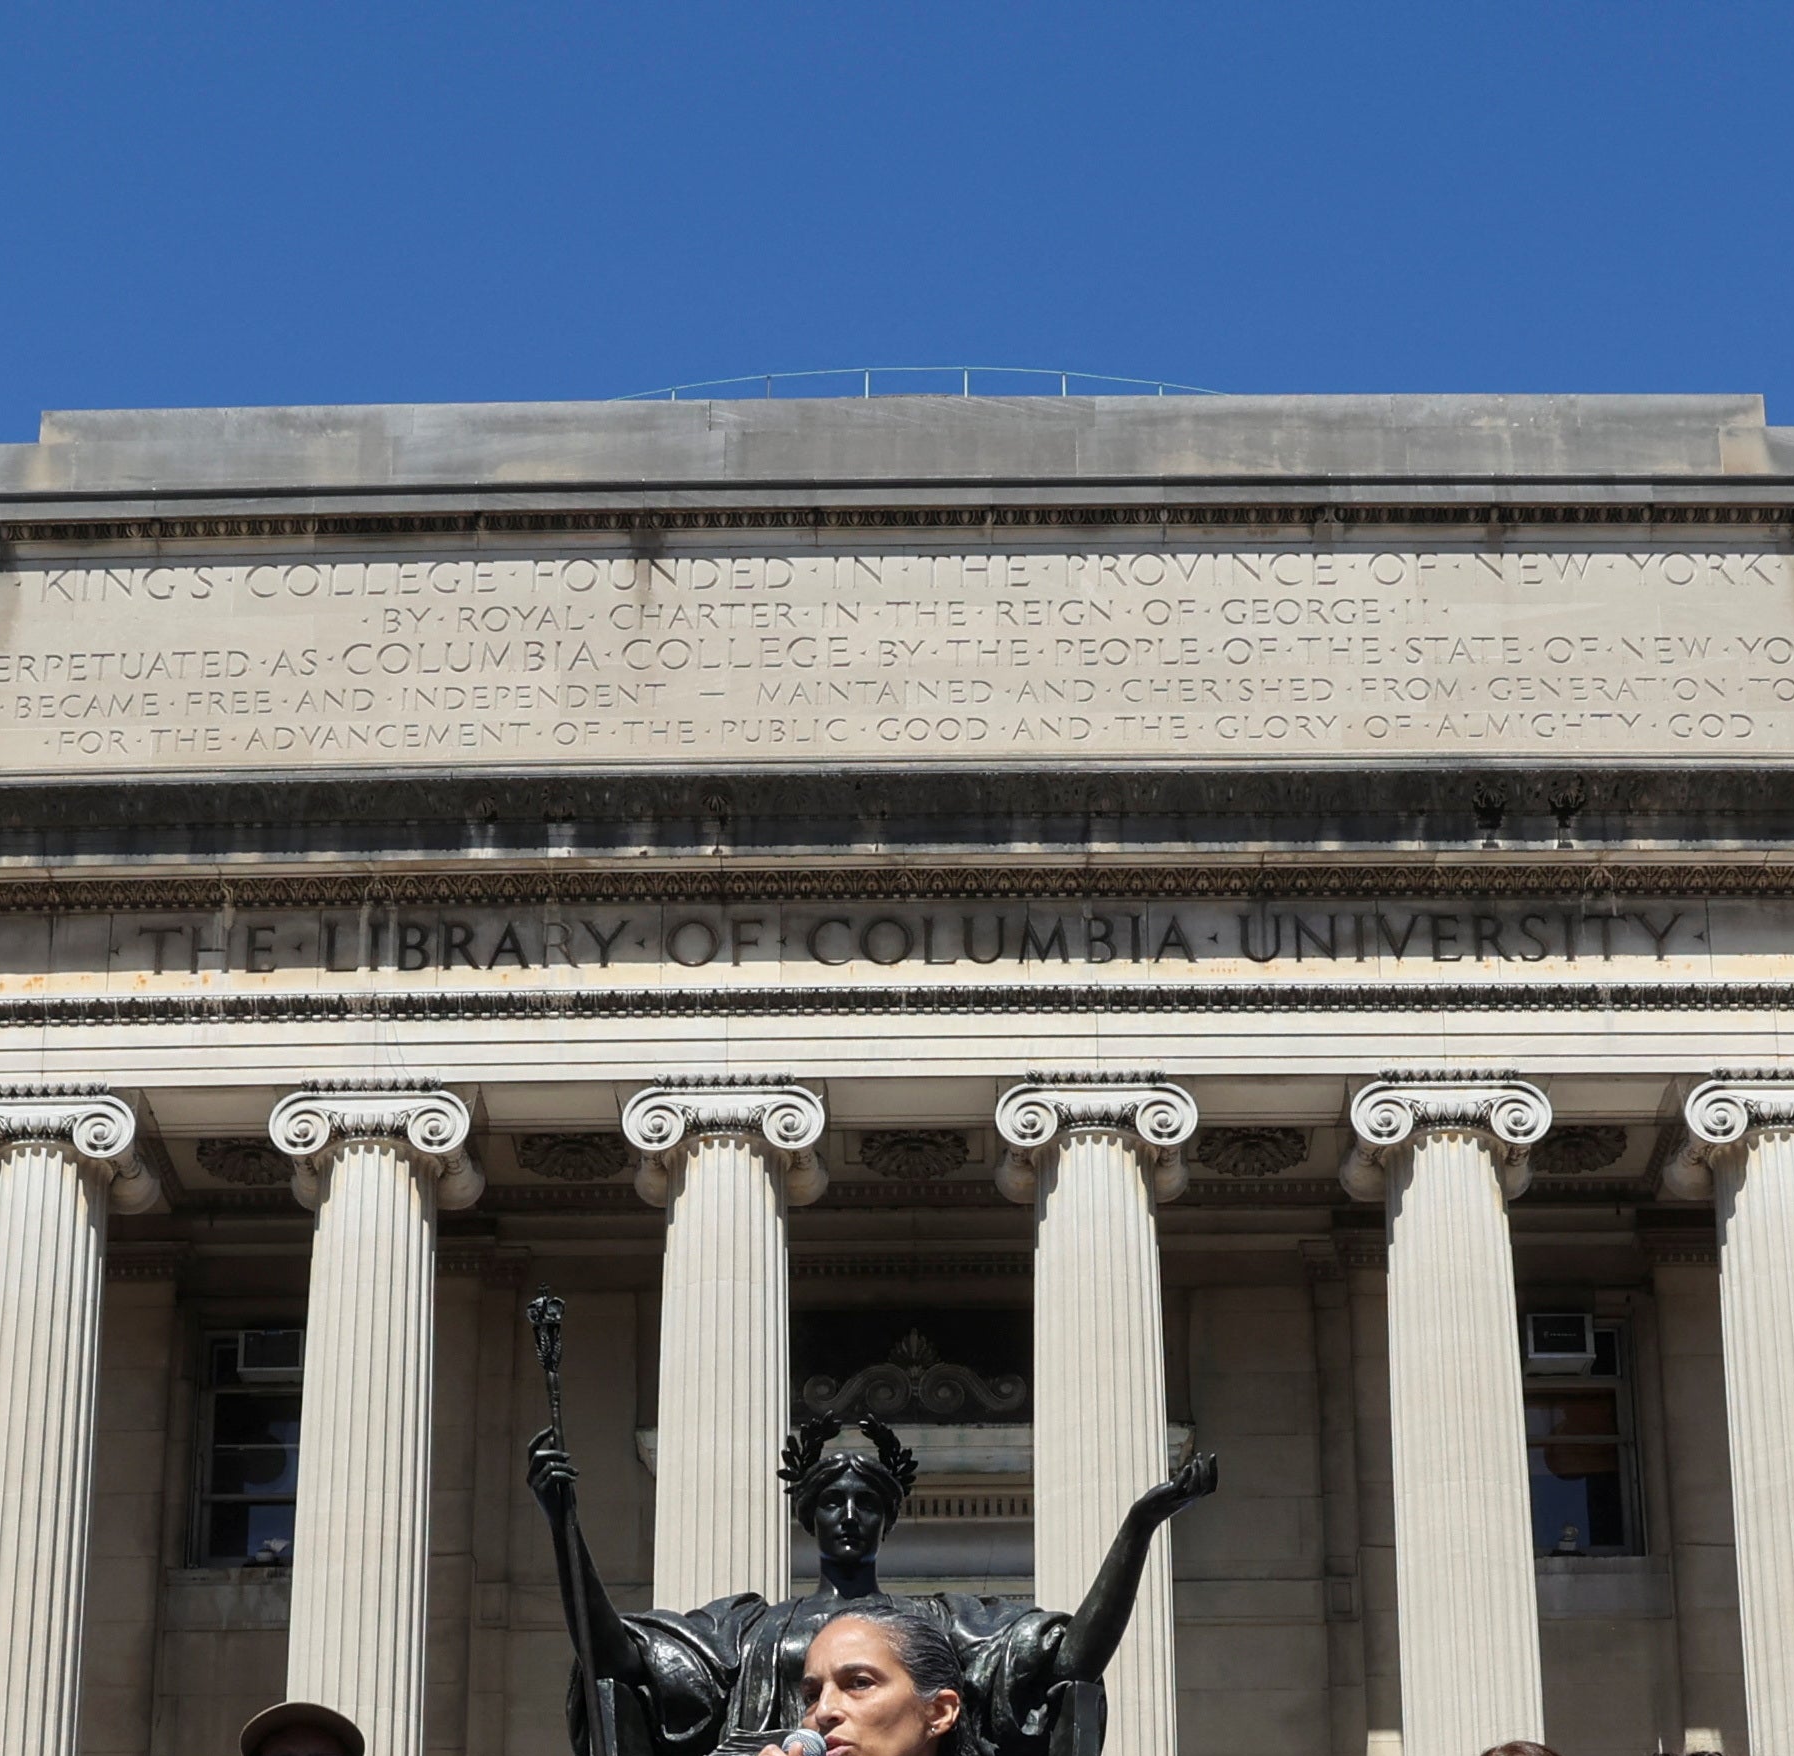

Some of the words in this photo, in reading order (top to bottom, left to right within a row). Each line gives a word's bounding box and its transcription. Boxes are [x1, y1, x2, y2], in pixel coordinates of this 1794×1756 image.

[41, 566, 214, 602] KING'S
[244, 561, 497, 599] COLLEGE
[532, 557, 796, 593] FOUNDED
[833, 556, 884, 590] IN
[918, 554, 1031, 588] THE
[1065, 552, 1338, 587] PROVINCE
[1368, 551, 1438, 586] OF
[1474, 552, 1594, 585] NEW
[1625, 551, 1777, 586] YORK
[382, 607, 432, 634] BY
[457, 605, 585, 632] ROYAL
[609, 603, 797, 631] CHARTER
[821, 601, 861, 627] IN
[885, 601, 968, 627] THE
[996, 600, 1114, 626] REIGN
[1142, 599, 1196, 625] OF
[1220, 598, 1382, 625] GEORGE
[270, 648, 319, 677] AS
[342, 640, 600, 677] COLUMBIA
[621, 637, 852, 671] COLLEGE
[878, 639, 926, 668] BY
[946, 638, 1030, 667] THE
[1055, 637, 1201, 667] PEOPLE
[1222, 637, 1279, 666] OF
[1297, 637, 1385, 665] THE
[1405, 637, 1522, 665] STATE
[1543, 637, 1599, 665] OF
[1621, 636, 1713, 665] NEW
[14, 693, 160, 720] BECAME
[185, 690, 273, 717] FREE
[295, 688, 375, 714] AND
[400, 683, 667, 713] INDEPENDENT
[756, 680, 994, 706] MAINTAINED
[1016, 679, 1095, 704] AND
[1120, 678, 1335, 704] CHERISHED
[1361, 677, 1464, 702] FROM
[1488, 677, 1726, 703] GENERATION
[57, 729, 128, 755] FOR
[150, 728, 223, 754] THE
[245, 721, 532, 752] ADVANCEMENT
[552, 721, 600, 747] OF
[623, 719, 696, 746] THE
[721, 718, 849, 744] PUBLIC
[876, 717, 990, 743] GOOD
[1012, 716, 1093, 742] AND
[1115, 715, 1189, 741] THE
[1215, 714, 1339, 740] GLORY
[1364, 714, 1412, 739] OF
[1436, 713, 1641, 740] ALMIGHTY
[1668, 712, 1755, 738] GOD
[139, 925, 277, 976] THE
[325, 920, 630, 973] LIBRARY
[666, 918, 765, 968] OF
[808, 914, 1198, 967] COLUMBIA
[1237, 911, 1683, 964] UNIVERSITY
